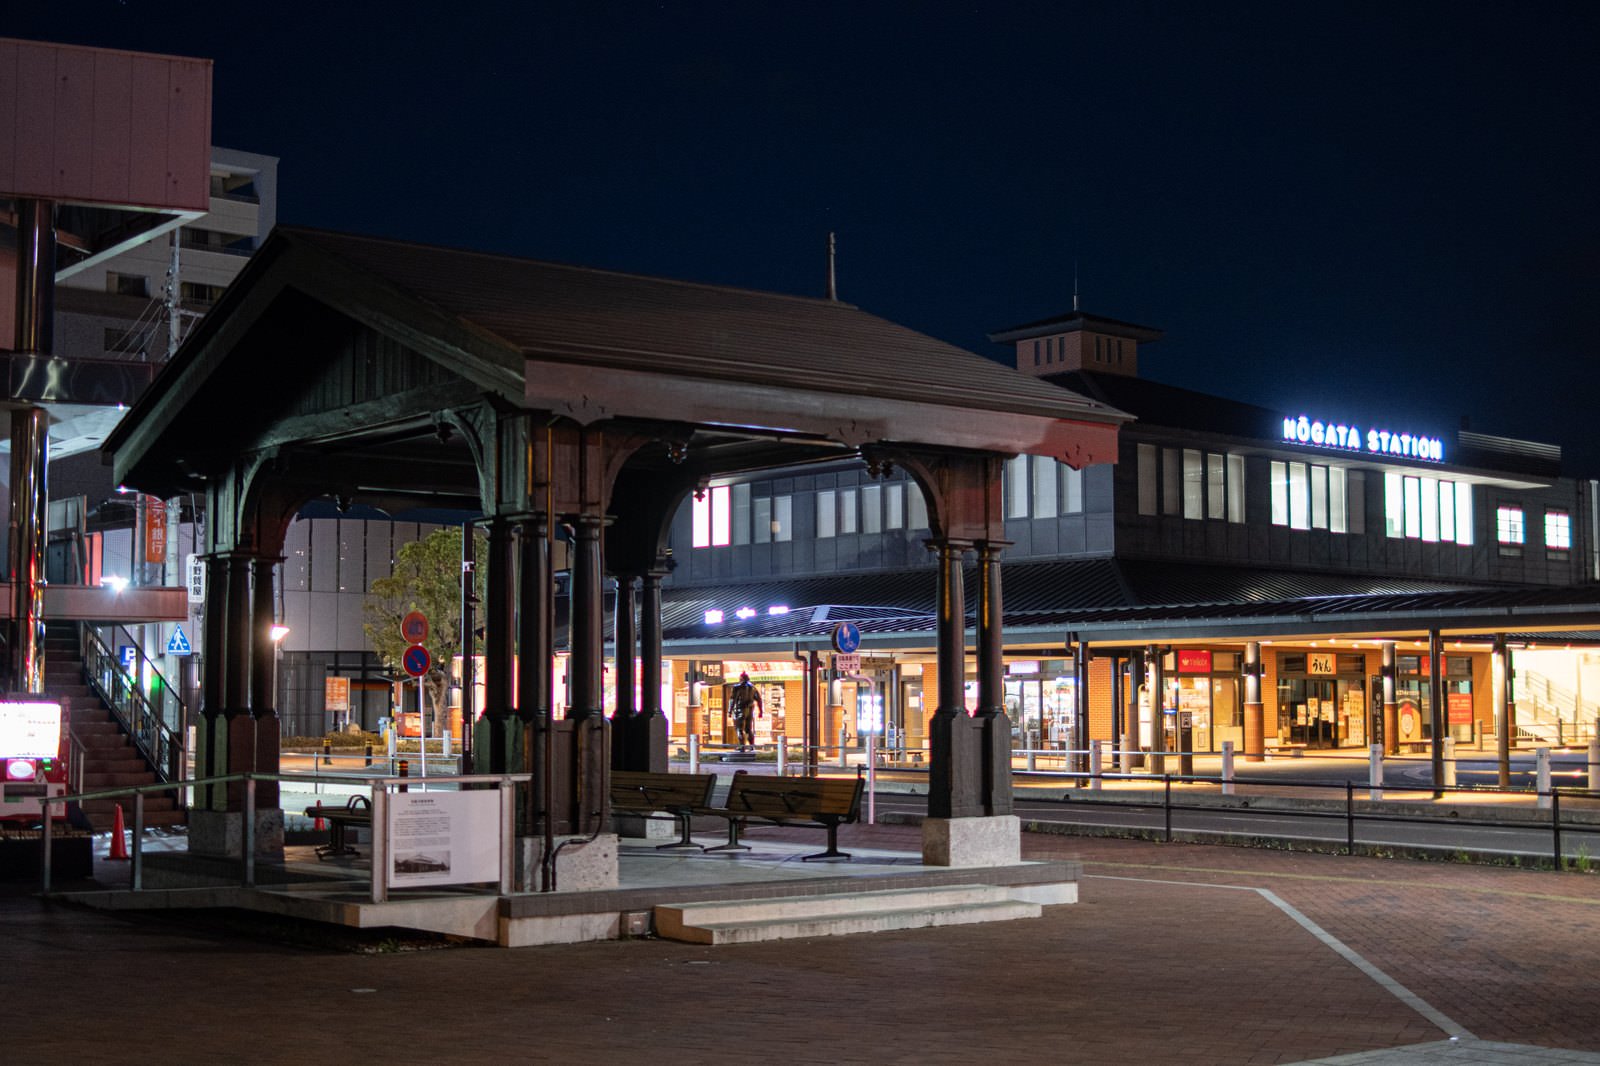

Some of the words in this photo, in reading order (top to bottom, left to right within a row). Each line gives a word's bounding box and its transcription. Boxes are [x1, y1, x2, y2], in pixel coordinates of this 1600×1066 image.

[1368, 429, 1443, 460] STATION
[1312, 658, 1332, 673] うどん
